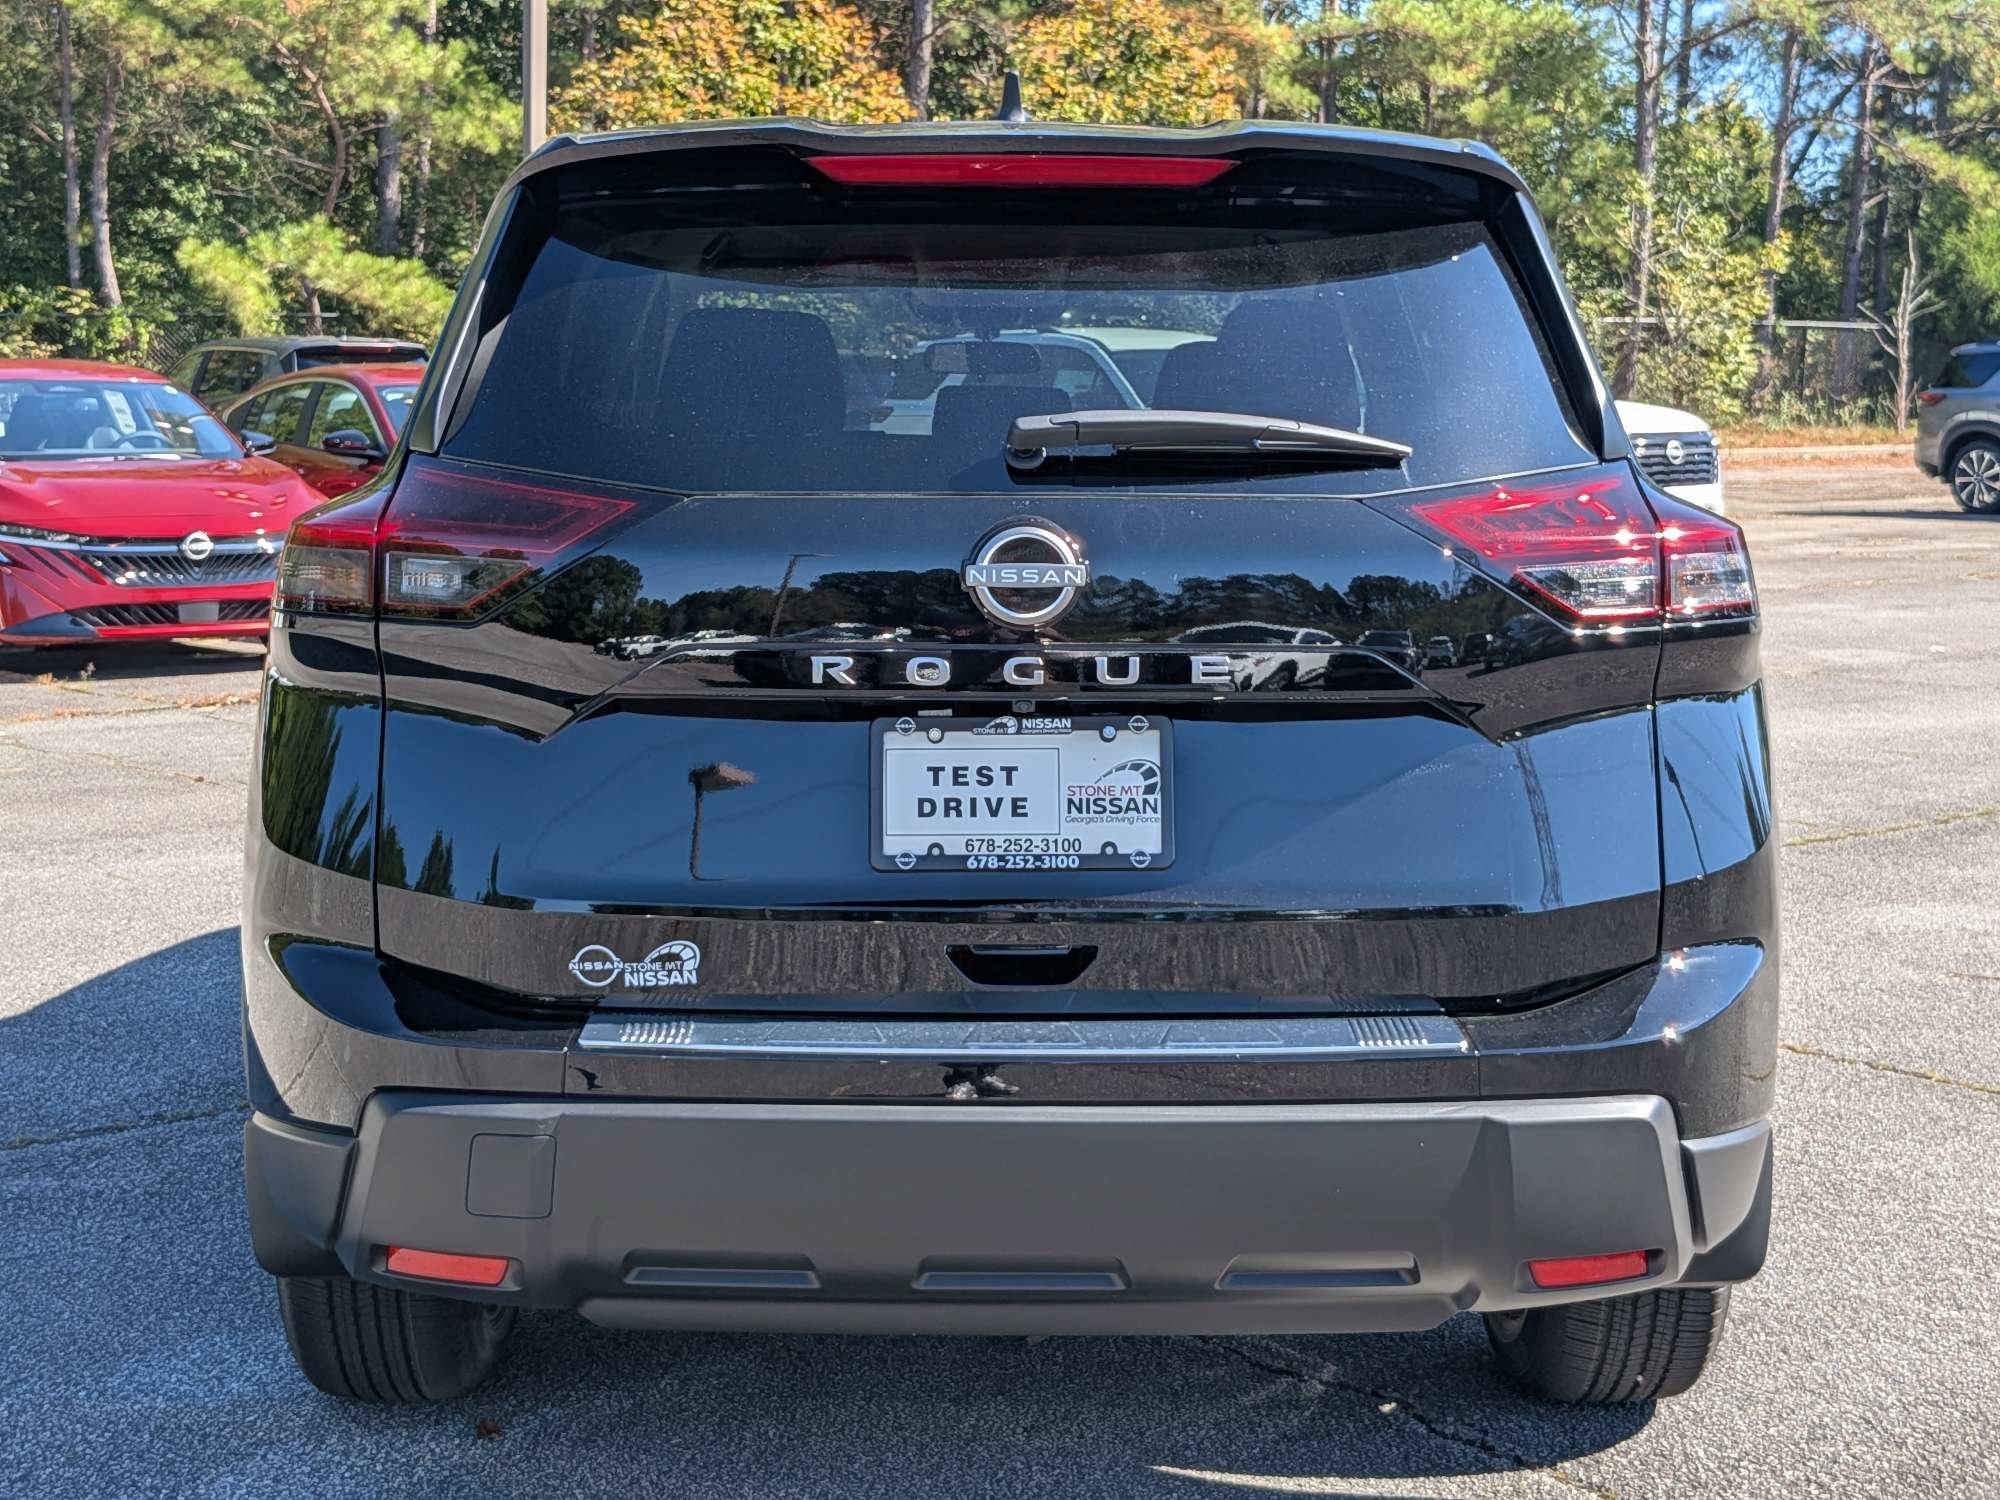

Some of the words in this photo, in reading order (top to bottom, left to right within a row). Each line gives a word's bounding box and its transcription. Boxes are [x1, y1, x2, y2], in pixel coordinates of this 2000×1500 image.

[969, 569, 1082, 584] NISSAN
[810, 655, 1233, 686] ROGUE
[1022, 718, 1072, 729] NISSAN
[926, 765, 1019, 787] TEST
[1067, 785, 1116, 797] STONE
[1119, 785, 1143, 797] MT
[917, 797, 1029, 818] DRIVE
[1067, 797, 1158, 815] NISSAN
[1064, 815, 1104, 825] Georgia's
[1105, 815, 1135, 825] Driving
[1136, 815, 1160, 823] Force
[965, 838, 1082, 853] 678-252-3100
[966, 855, 1080, 869] 678-252-3100
[568, 960, 623, 971] NISSAN
[623, 961, 663, 972] STONE
[665, 960, 683, 971] MT
[624, 970, 698, 988] NISSAN
